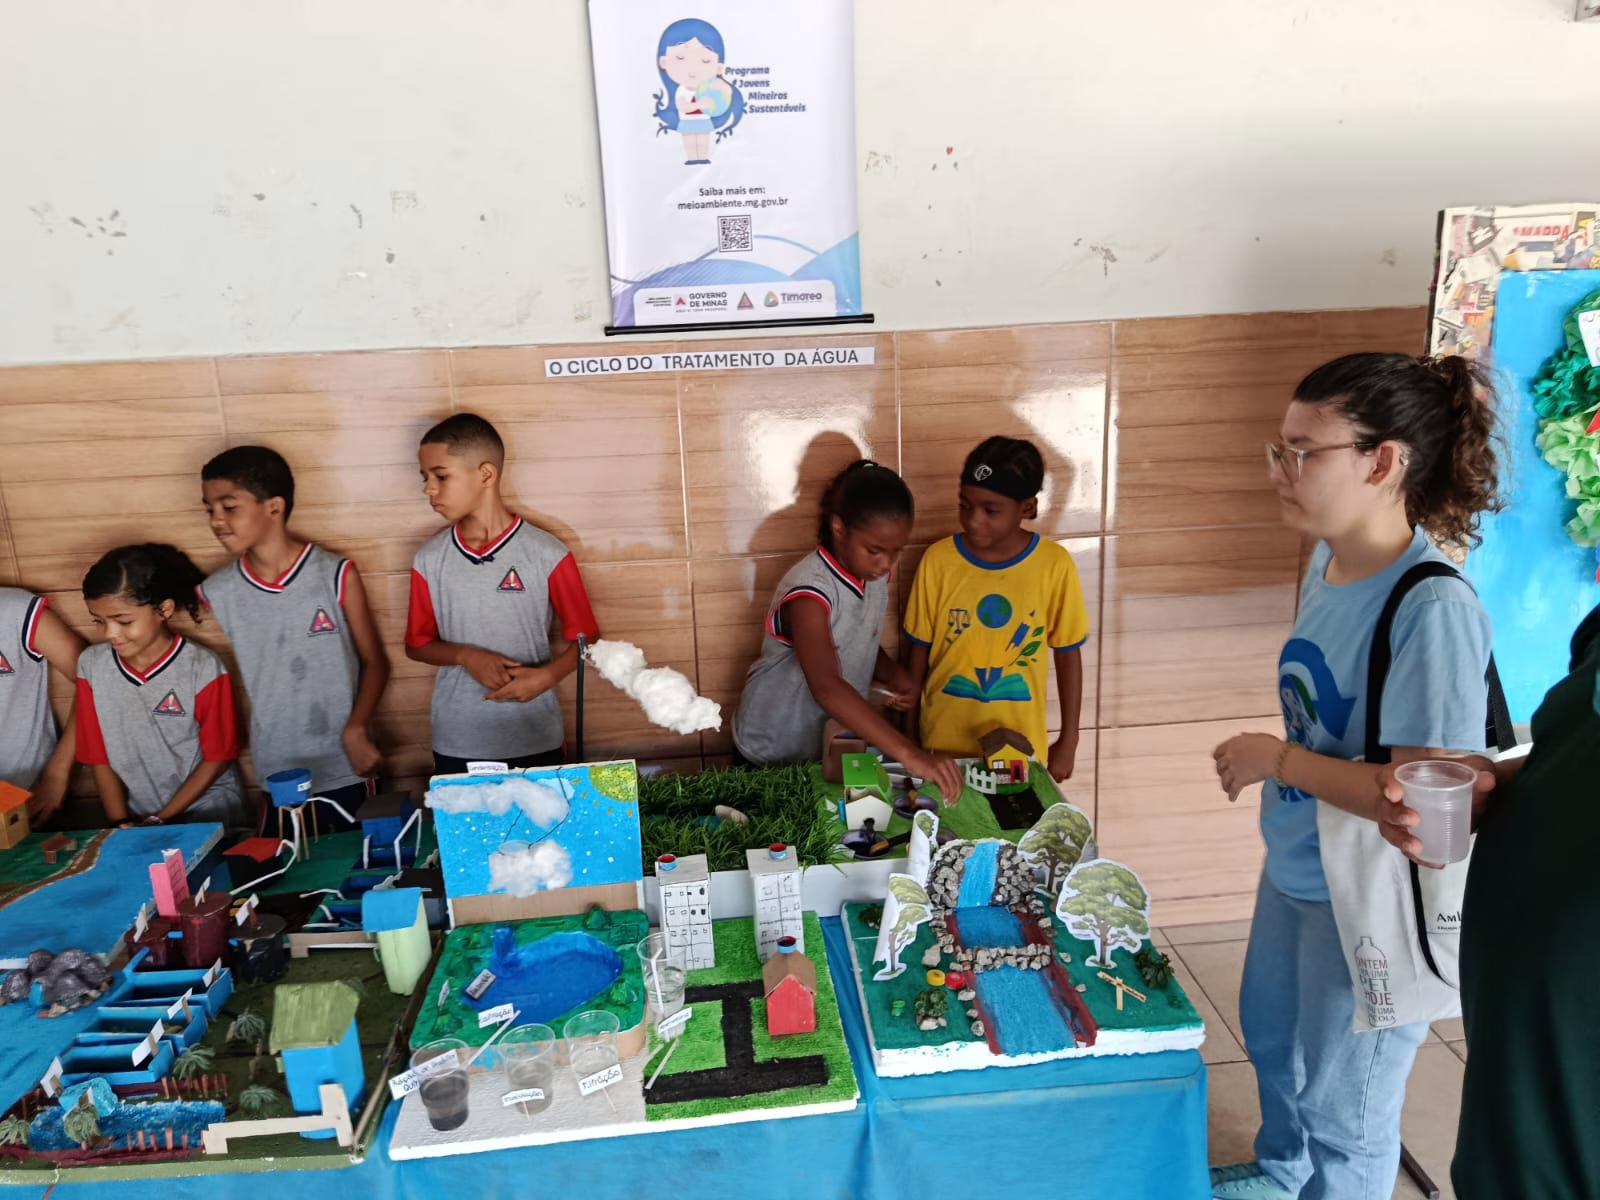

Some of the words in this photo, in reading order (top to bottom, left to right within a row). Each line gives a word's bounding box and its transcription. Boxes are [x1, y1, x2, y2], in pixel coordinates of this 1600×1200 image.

[725, 66, 770, 77] Programa
[738, 79, 770, 88] Jovens
[748, 91, 788, 101] Mineiros
[749, 103, 806, 113] Sustentáveis
[699, 187, 723, 196] Saiba
[725, 186, 746, 195] mais
[749, 187, 766, 195] em:
[678, 196, 788, 210] meioambiente.mg.gov.br
[689, 291, 728, 300] GOVERNO
[689, 300, 701, 308] DE
[702, 299, 728, 308] MINAS
[549, 362, 562, 375] O
[567, 358, 622, 374] CICLO
[627, 356, 653, 370] DO
[662, 352, 776, 370] TRATAMENTO
[784, 352, 808, 366] DA
[812, 348, 859, 365] ÁGUA
